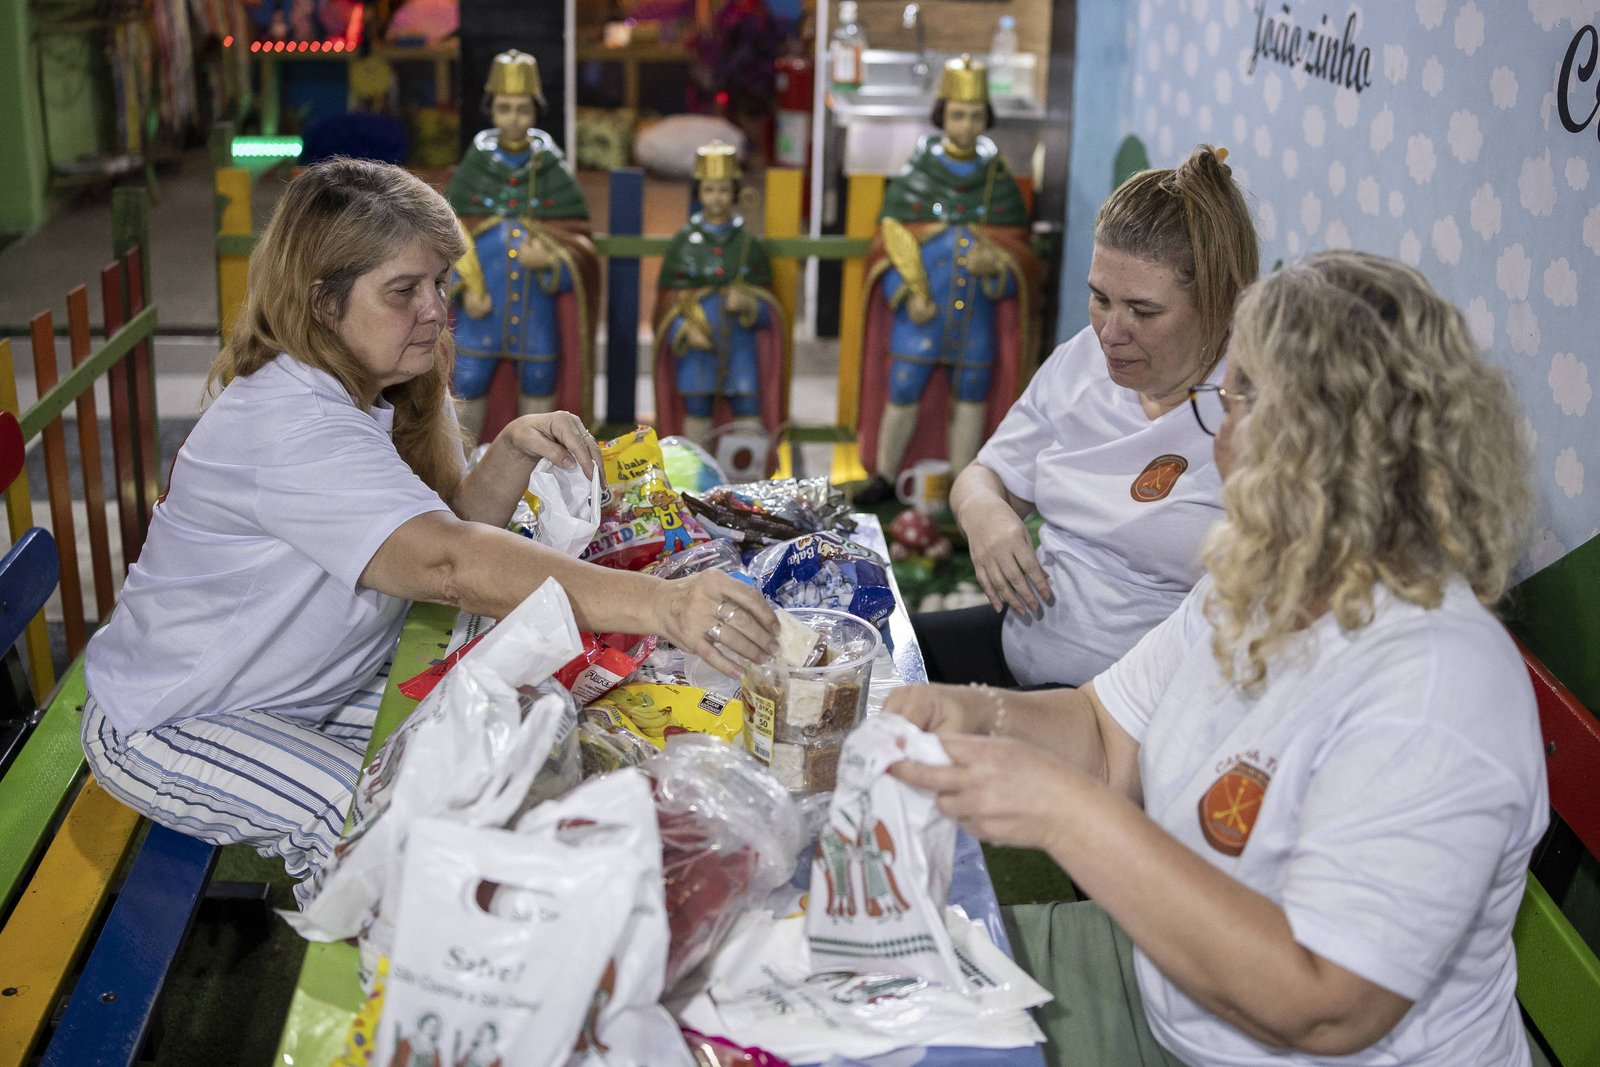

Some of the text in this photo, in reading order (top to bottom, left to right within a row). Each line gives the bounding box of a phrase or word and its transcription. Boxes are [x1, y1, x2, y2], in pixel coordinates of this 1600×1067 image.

[664, 512, 675, 527] J
[578, 521, 650, 560] ORTIDA
[759, 718, 769, 728] 50
